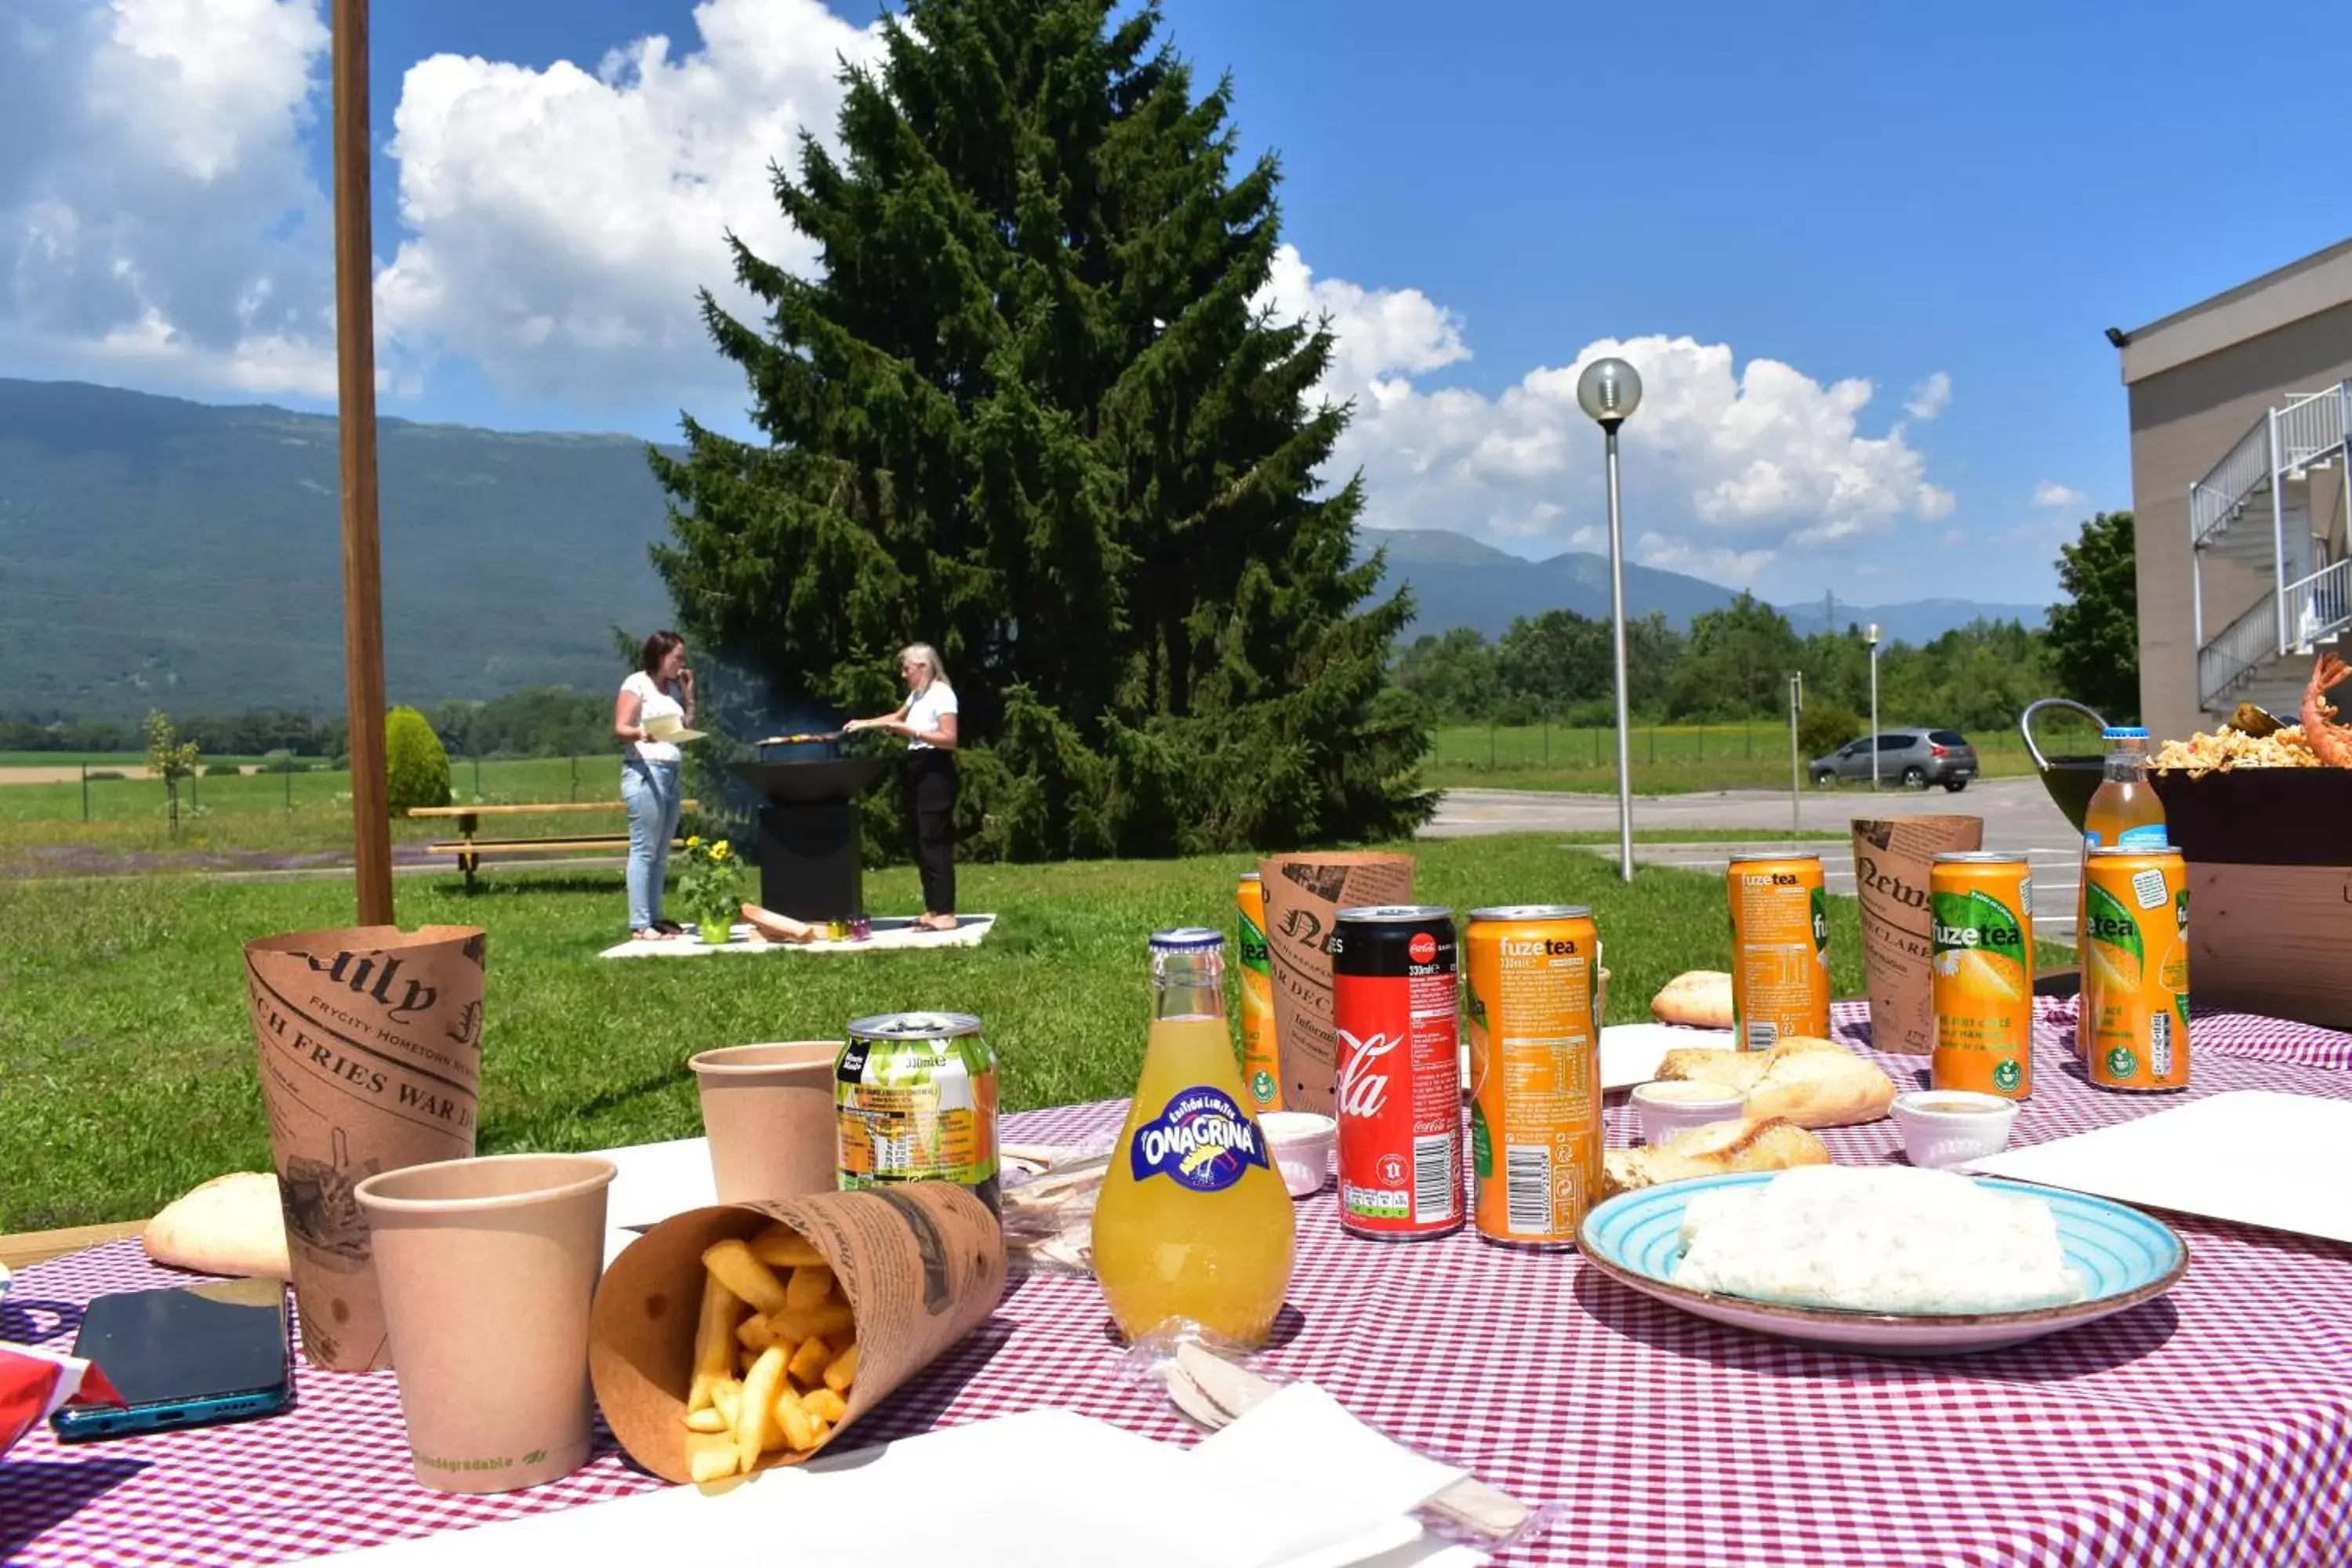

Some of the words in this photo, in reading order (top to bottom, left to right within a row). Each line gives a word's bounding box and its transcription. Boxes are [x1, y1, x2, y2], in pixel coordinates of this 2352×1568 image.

[1742, 871, 1797, 886] fuzetea
[1500, 937, 1575, 956] fuzetea
[309, 995, 372, 1033] FRYCITY
[376, 1029, 452, 1067] HOMETOWN
[292, 1031, 388, 1094] FRIES
[399, 1082, 455, 1121] WAR
[1145, 1116, 1254, 1166] ONAGRINA
